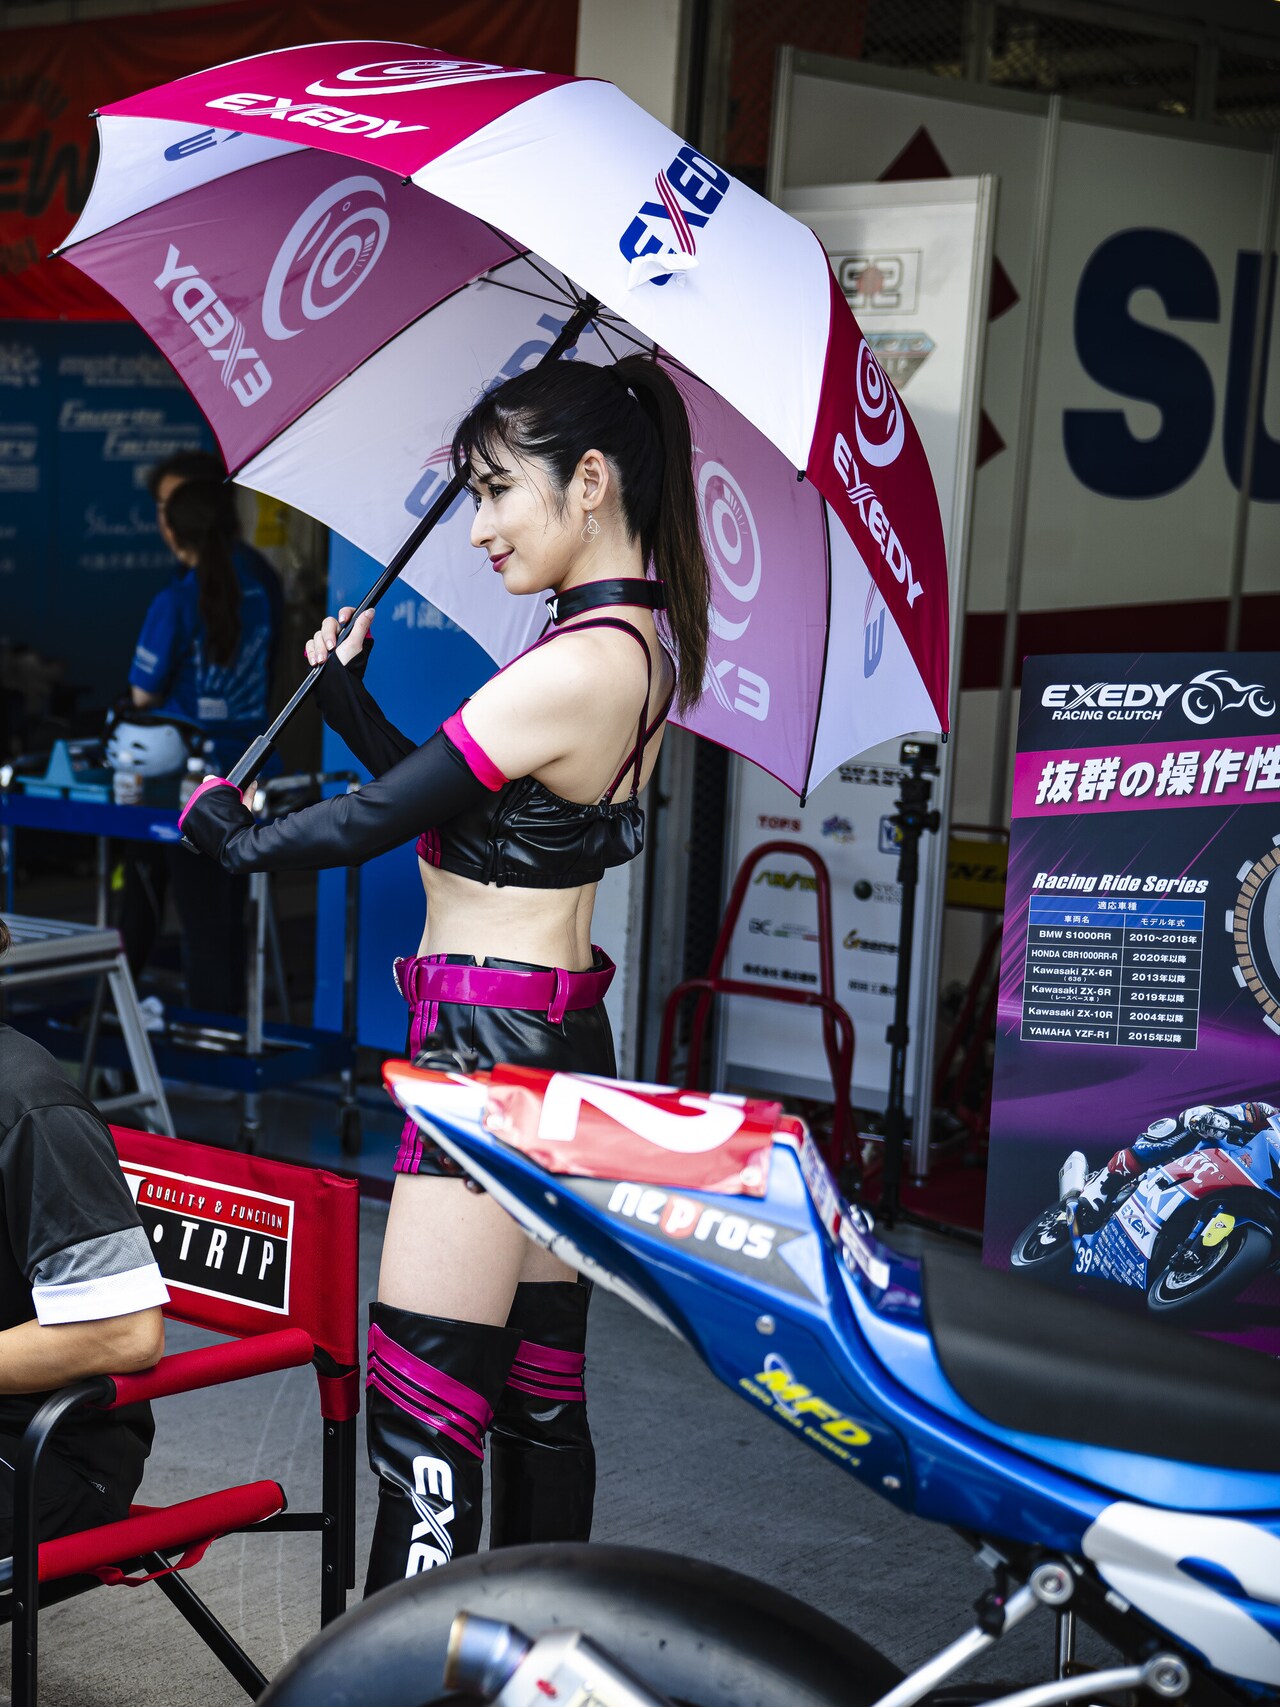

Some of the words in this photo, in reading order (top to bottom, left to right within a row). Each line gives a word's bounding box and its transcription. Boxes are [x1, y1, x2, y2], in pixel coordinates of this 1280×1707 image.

[205, 92, 431, 140] EXEDY
[619, 140, 734, 286] EXED
[833, 432, 924, 609] EXEDY
[1041, 682, 1183, 710] EXEDY
[1051, 710, 1103, 721] RACING
[1107, 710, 1163, 721] CLUTCH
[1035, 745, 1280, 805] 抜群の操作性
[1032, 872, 1098, 892] Racing
[1098, 874, 1142, 892] Ride
[1142, 875, 1209, 894] Series
[1063, 915, 1090, 924] 車両名
[1140, 917, 1185, 927] モデル年式
[1039, 930, 1063, 938] BMW
[1065, 931, 1112, 941] S1000RR
[1031, 949, 1060, 958] HONDA
[1062, 950, 1118, 960] CBR1000RR-R
[1132, 953, 1187, 964] 2020年以降
[1032, 966, 1079, 976] Kawasaki
[1081, 968, 1113, 977] ZX-6R
[1131, 973, 1186, 983] 2013年以降
[1031, 985, 1078, 995] Kawasaki
[1080, 987, 1111, 996] ZX-6R
[1130, 992, 1185, 1003] 2019年以降
[1028, 1007, 1075, 1017] Kawasaki
[1077, 1009, 1113, 1019] ZX-10R
[1129, 1012, 1184, 1023] 2004年以降
[1029, 1027, 1072, 1037] YAMAHA
[1074, 1029, 1110, 1039] YZF-R1
[1128, 1032, 1182, 1043] 2015年以降
[147, 1184, 206, 1210] QUALITY
[214, 1200, 222, 1214] &
[231, 1204, 283, 1230] FUNCTION
[608, 1182, 776, 1260] nepros
[1121, 1204, 1150, 1239] EXEDY
[1076, 1246, 1093, 1273] 39
[754, 1369, 872, 1447] MFD
[405, 1455, 455, 1579] EXE
